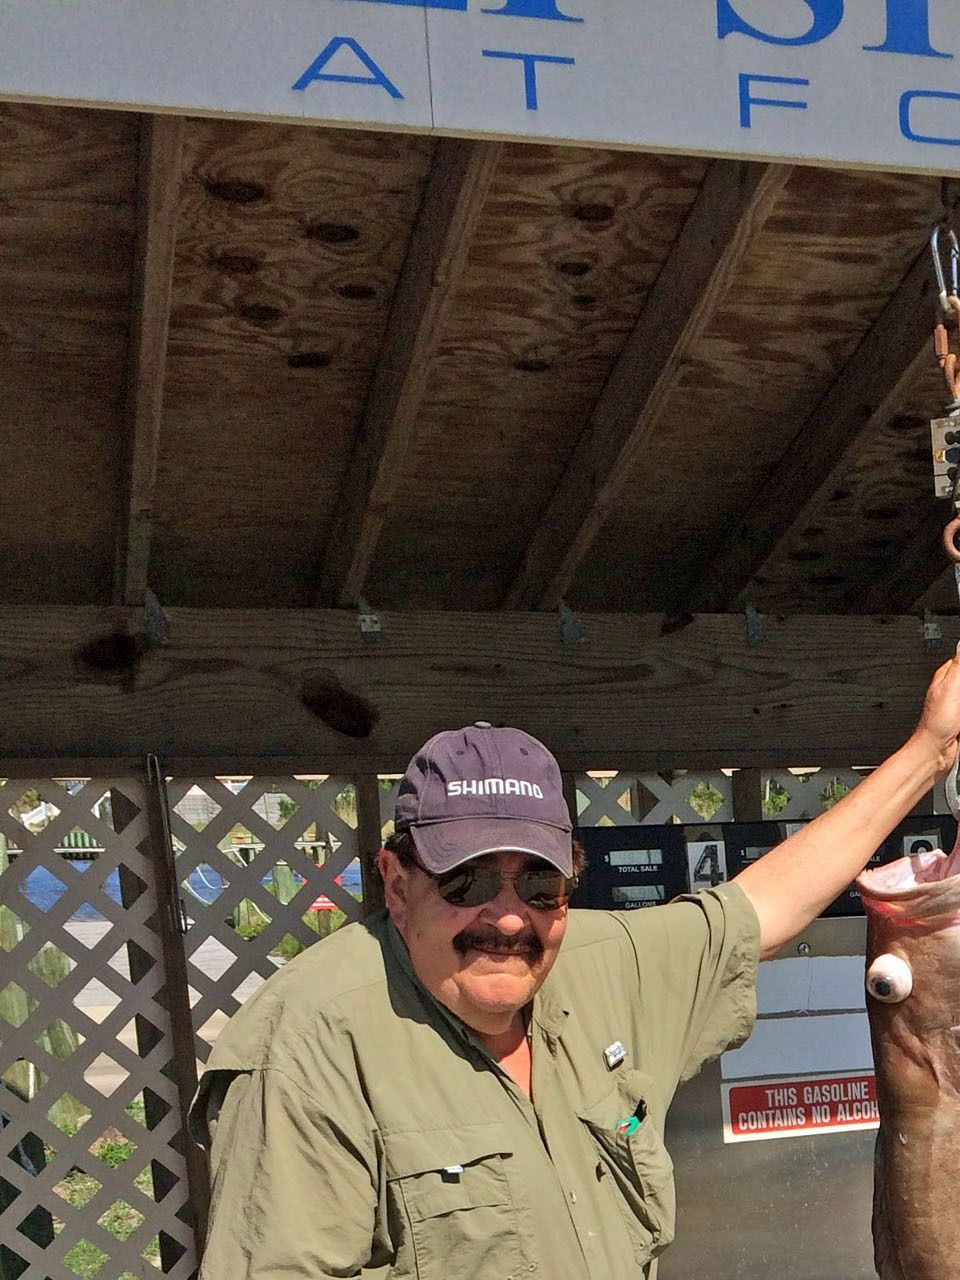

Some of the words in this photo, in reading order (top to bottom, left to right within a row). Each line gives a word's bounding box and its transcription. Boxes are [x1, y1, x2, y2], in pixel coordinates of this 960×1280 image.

[291, 36, 576, 111] AT
[447, 778, 544, 799] SHIMANO
[693, 844, 725, 888] 4
[624, 901, 657, 909] GALLONS
[765, 1088, 797, 1108] THIS
[803, 1081, 869, 1105] GASOLINE
[738, 1107, 806, 1131] CONTAINS
[812, 1104, 831, 1124] NO
